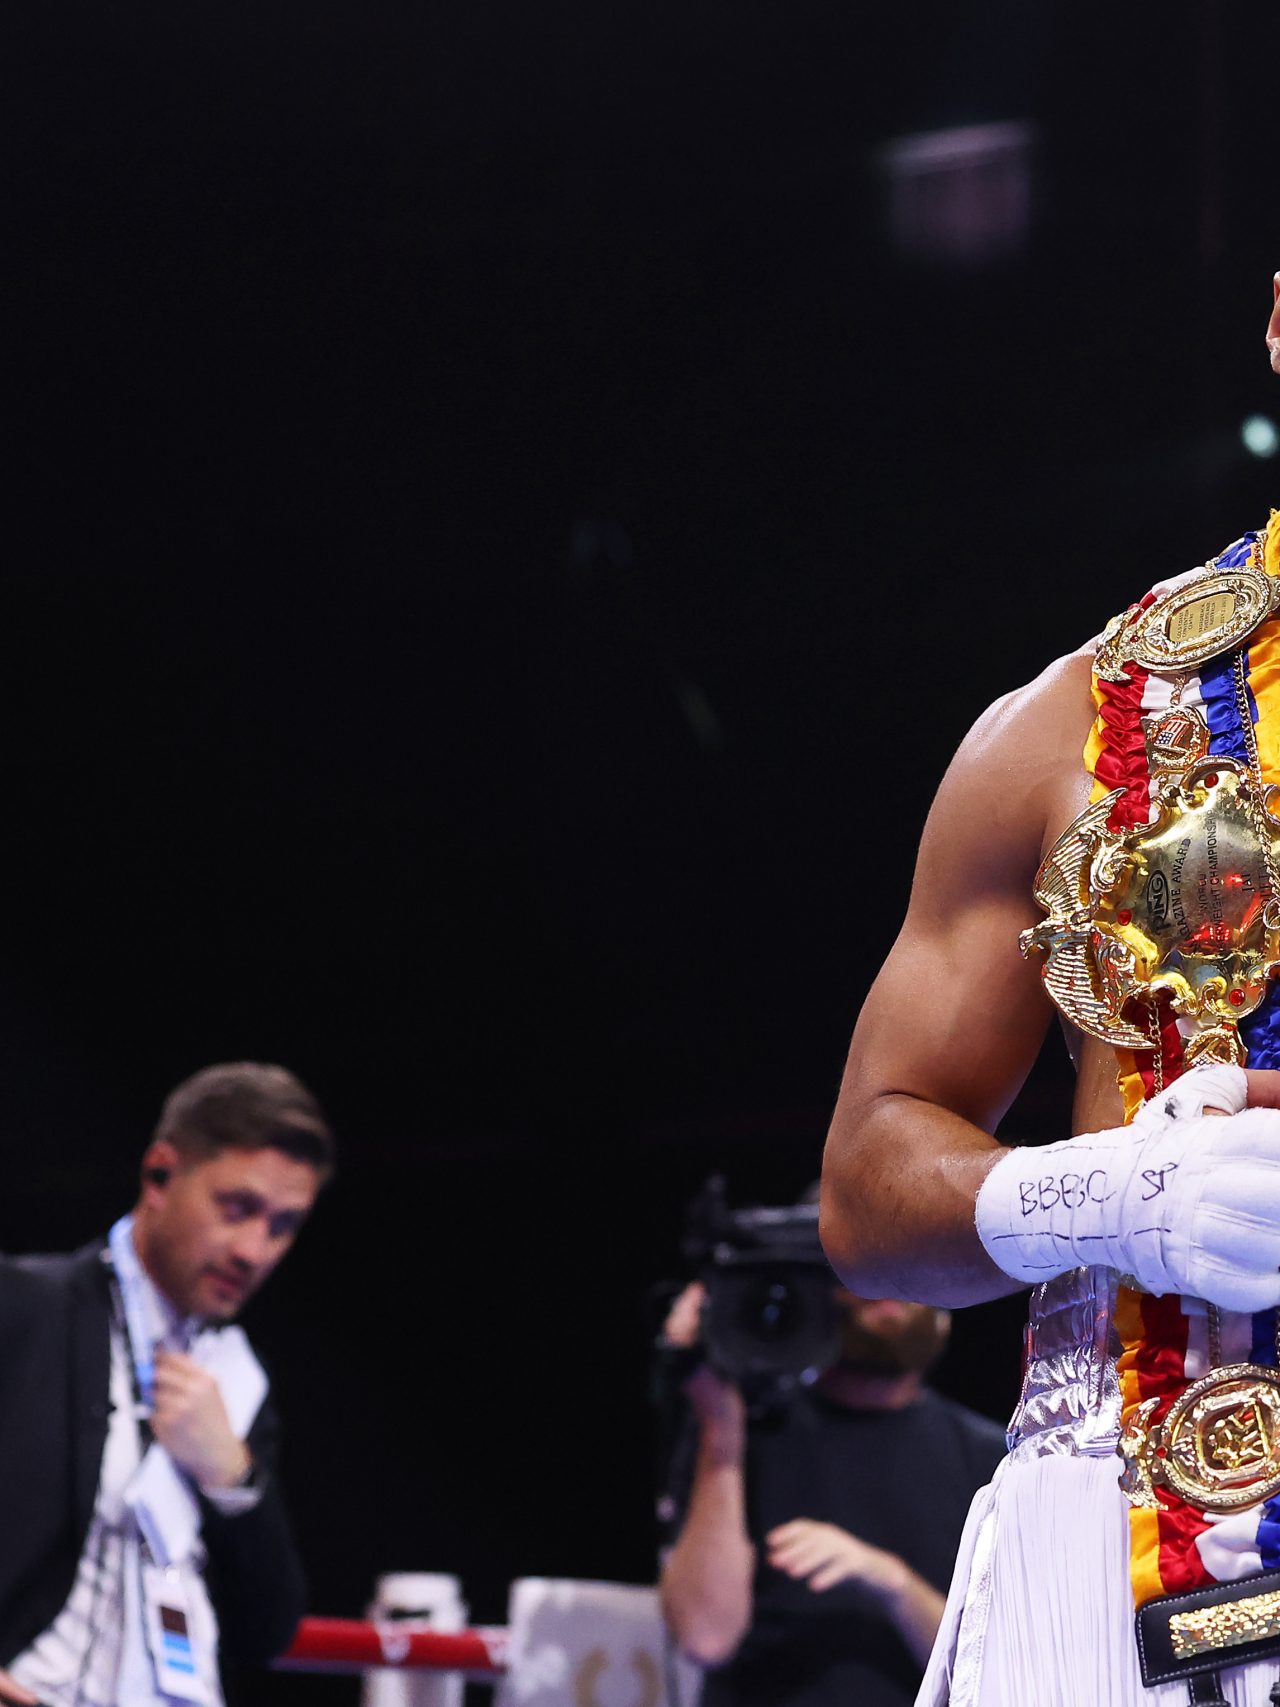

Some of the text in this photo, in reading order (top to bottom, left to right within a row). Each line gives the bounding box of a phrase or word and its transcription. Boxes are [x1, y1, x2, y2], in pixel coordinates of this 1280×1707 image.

[1172, 838, 1191, 883] AWARD
[1207, 810, 1219, 885] CHAMPIONSHIP
[1147, 874, 1171, 935] RING
[1018, 1169, 1115, 1217] BBBC
